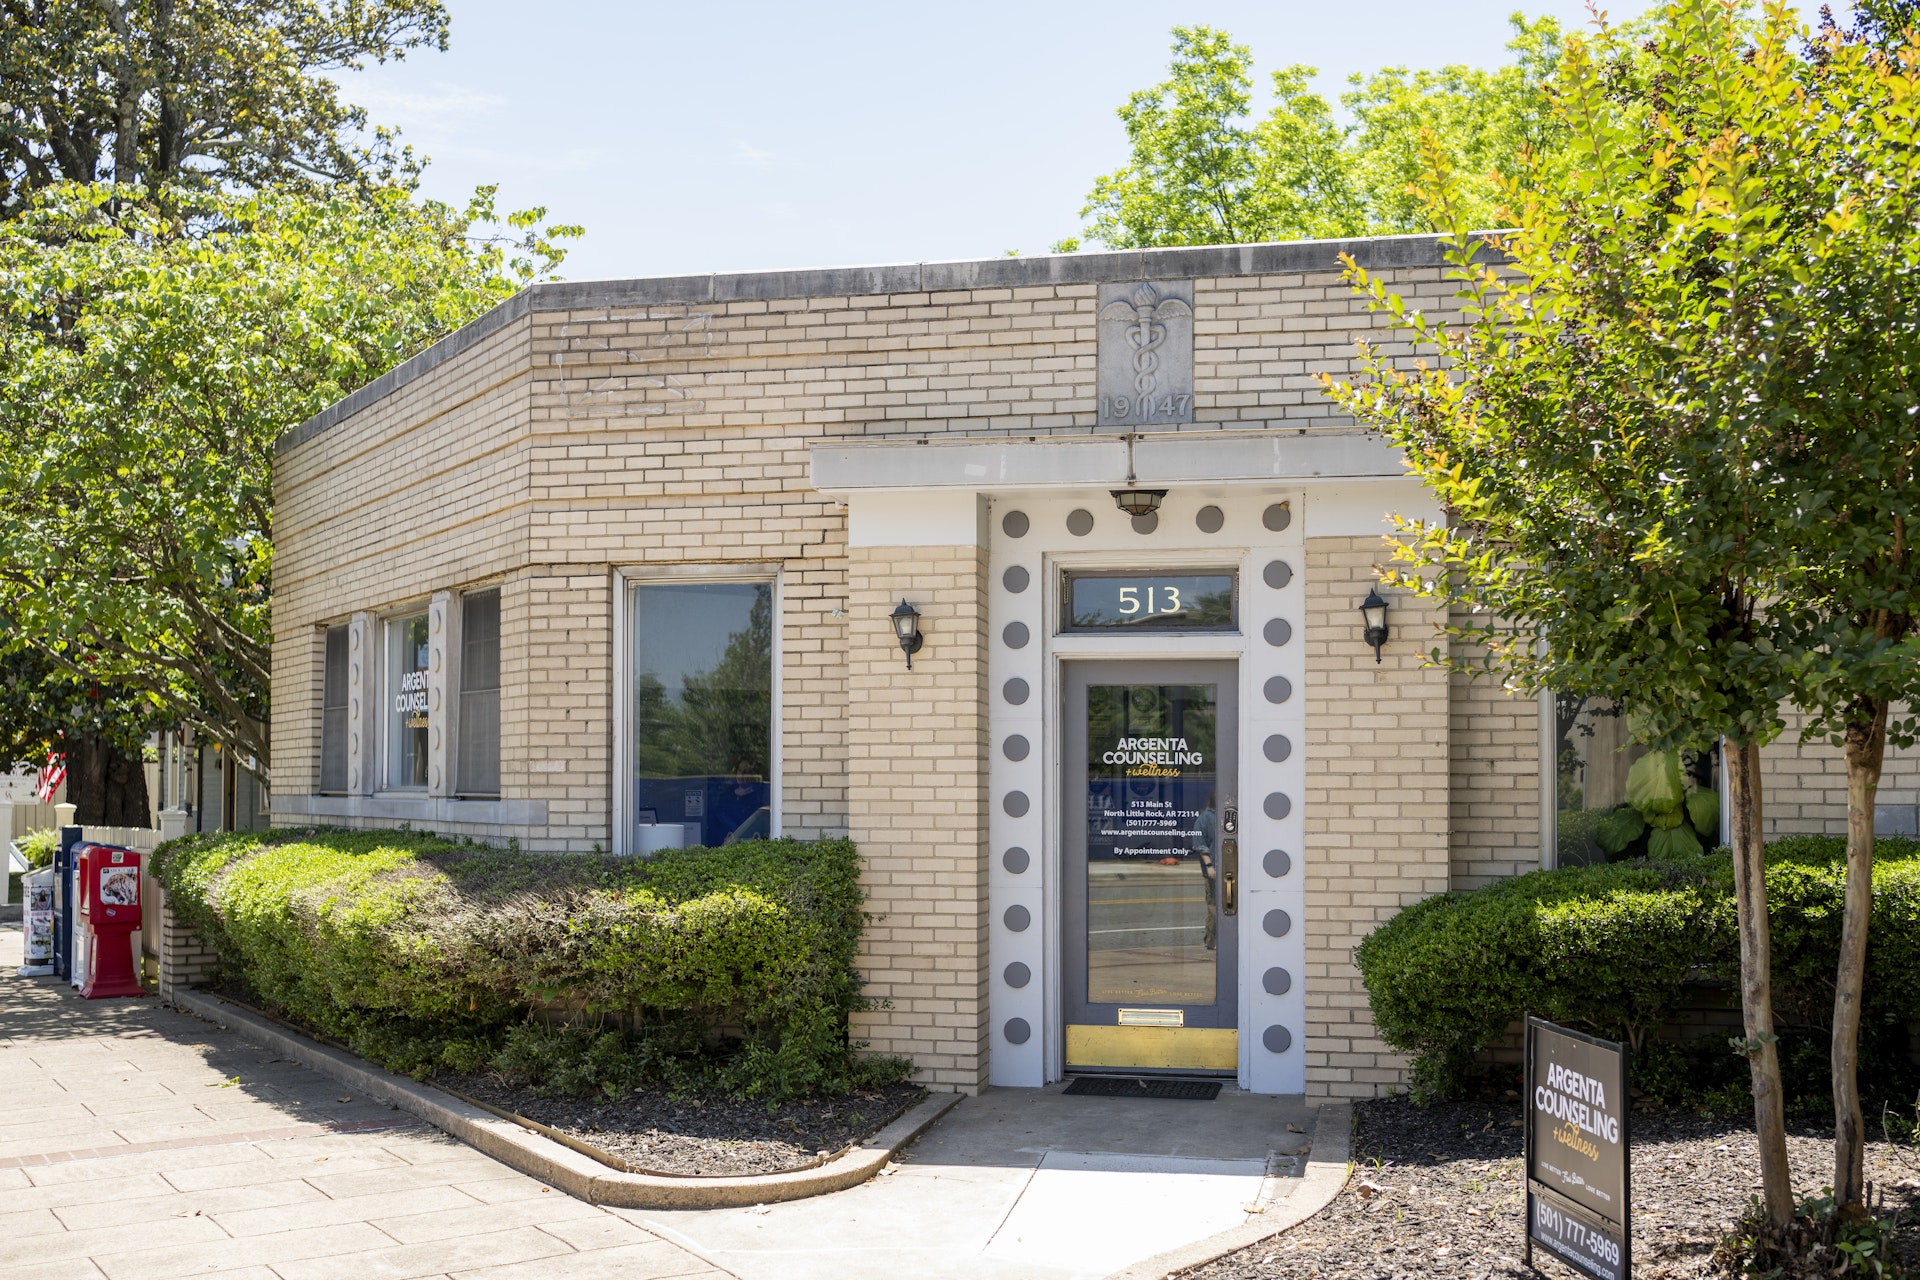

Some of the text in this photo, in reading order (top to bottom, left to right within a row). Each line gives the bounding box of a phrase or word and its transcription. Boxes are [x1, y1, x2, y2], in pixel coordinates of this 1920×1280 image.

[1102, 394, 1191, 419] 19 47
[1119, 586, 1181, 614] 513
[402, 671, 429, 691] ARGENT
[395, 692, 428, 712] COUNSEL
[1116, 737, 1189, 751] ARGENTA
[1102, 751, 1203, 765] COUNSELING
[1126, 810, 1145, 818] Little
[1146, 810, 1165, 818] Rock,
[1101, 829, 1202, 837] www.argentacounseling.com
[1114, 847, 1189, 856] By Appointment Only
[1547, 1062, 1606, 1109] ARGENTA
[1535, 1085, 1619, 1144] COUNSELING
[1536, 1201, 1620, 1267] (501) 777-5969
[1540, 1231, 1615, 1280] www.argentacounseling.com
